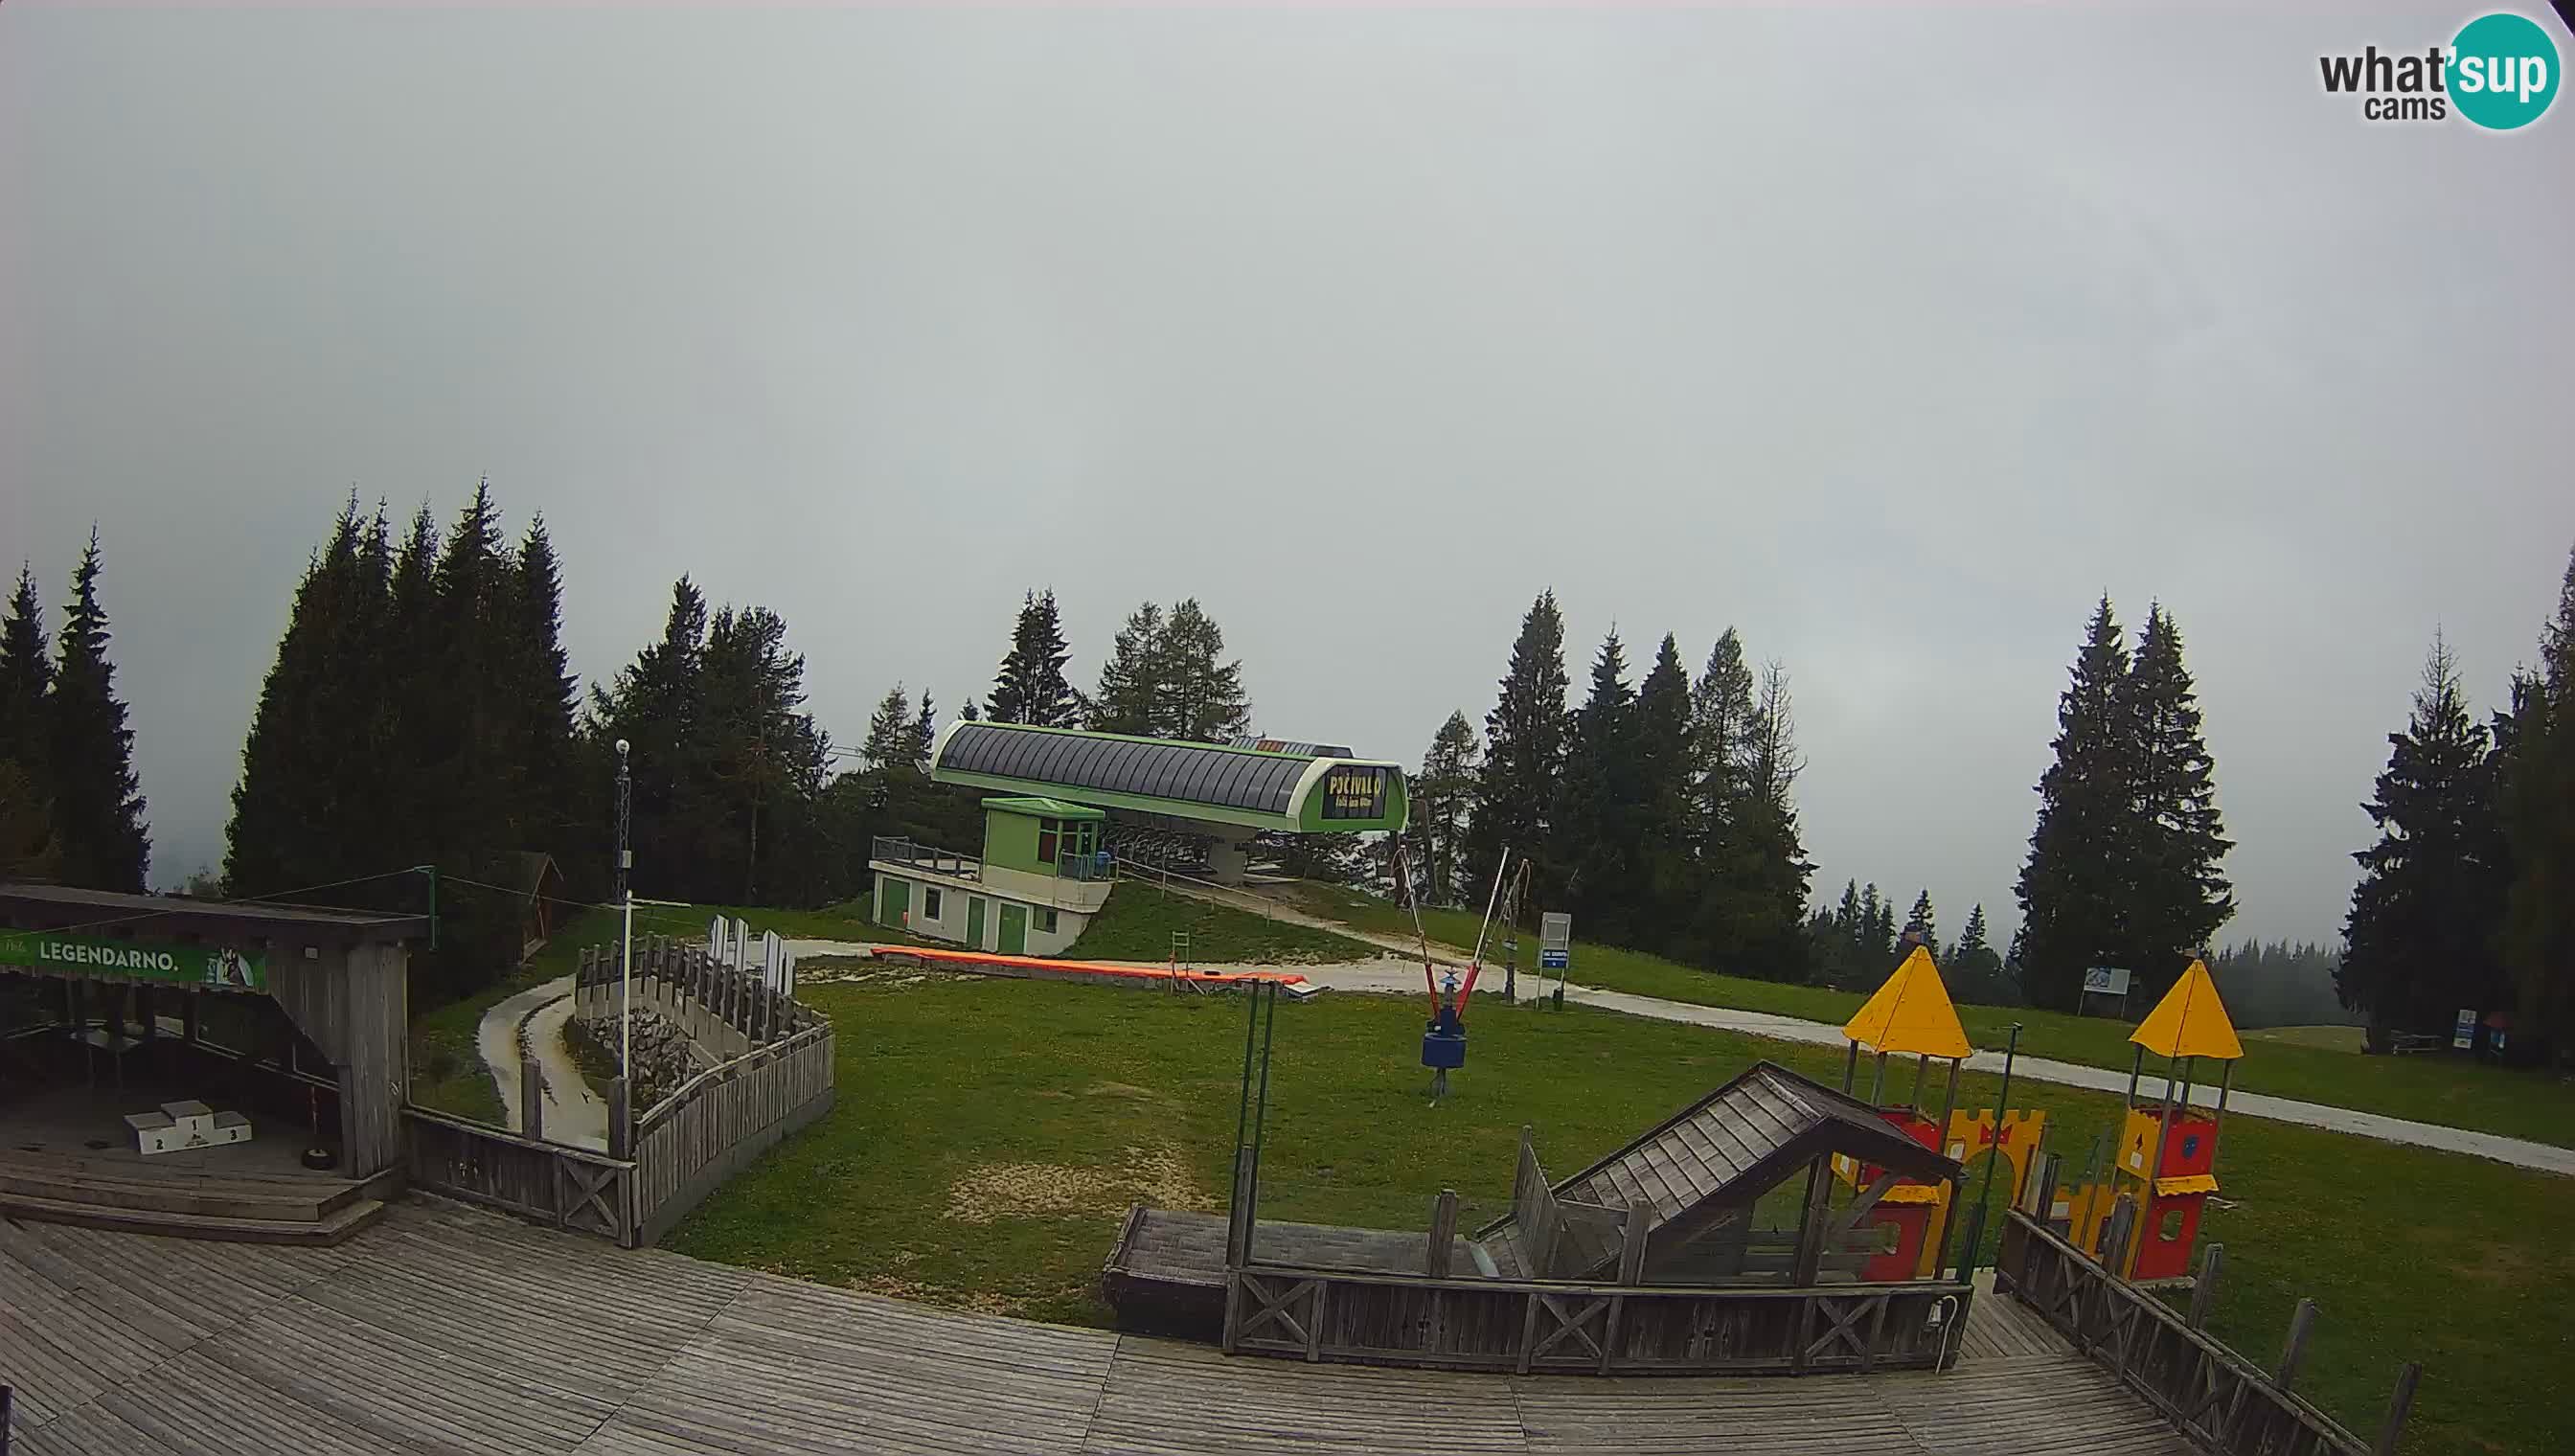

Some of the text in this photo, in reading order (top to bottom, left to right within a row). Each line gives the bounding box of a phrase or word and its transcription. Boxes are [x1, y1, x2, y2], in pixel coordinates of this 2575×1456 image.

[38, 941, 179, 972] LEGENDARNO.
[192, 1119, 197, 1131] 1
[230, 1128, 238, 1141] 3
[156, 1138, 164, 1150] 2
